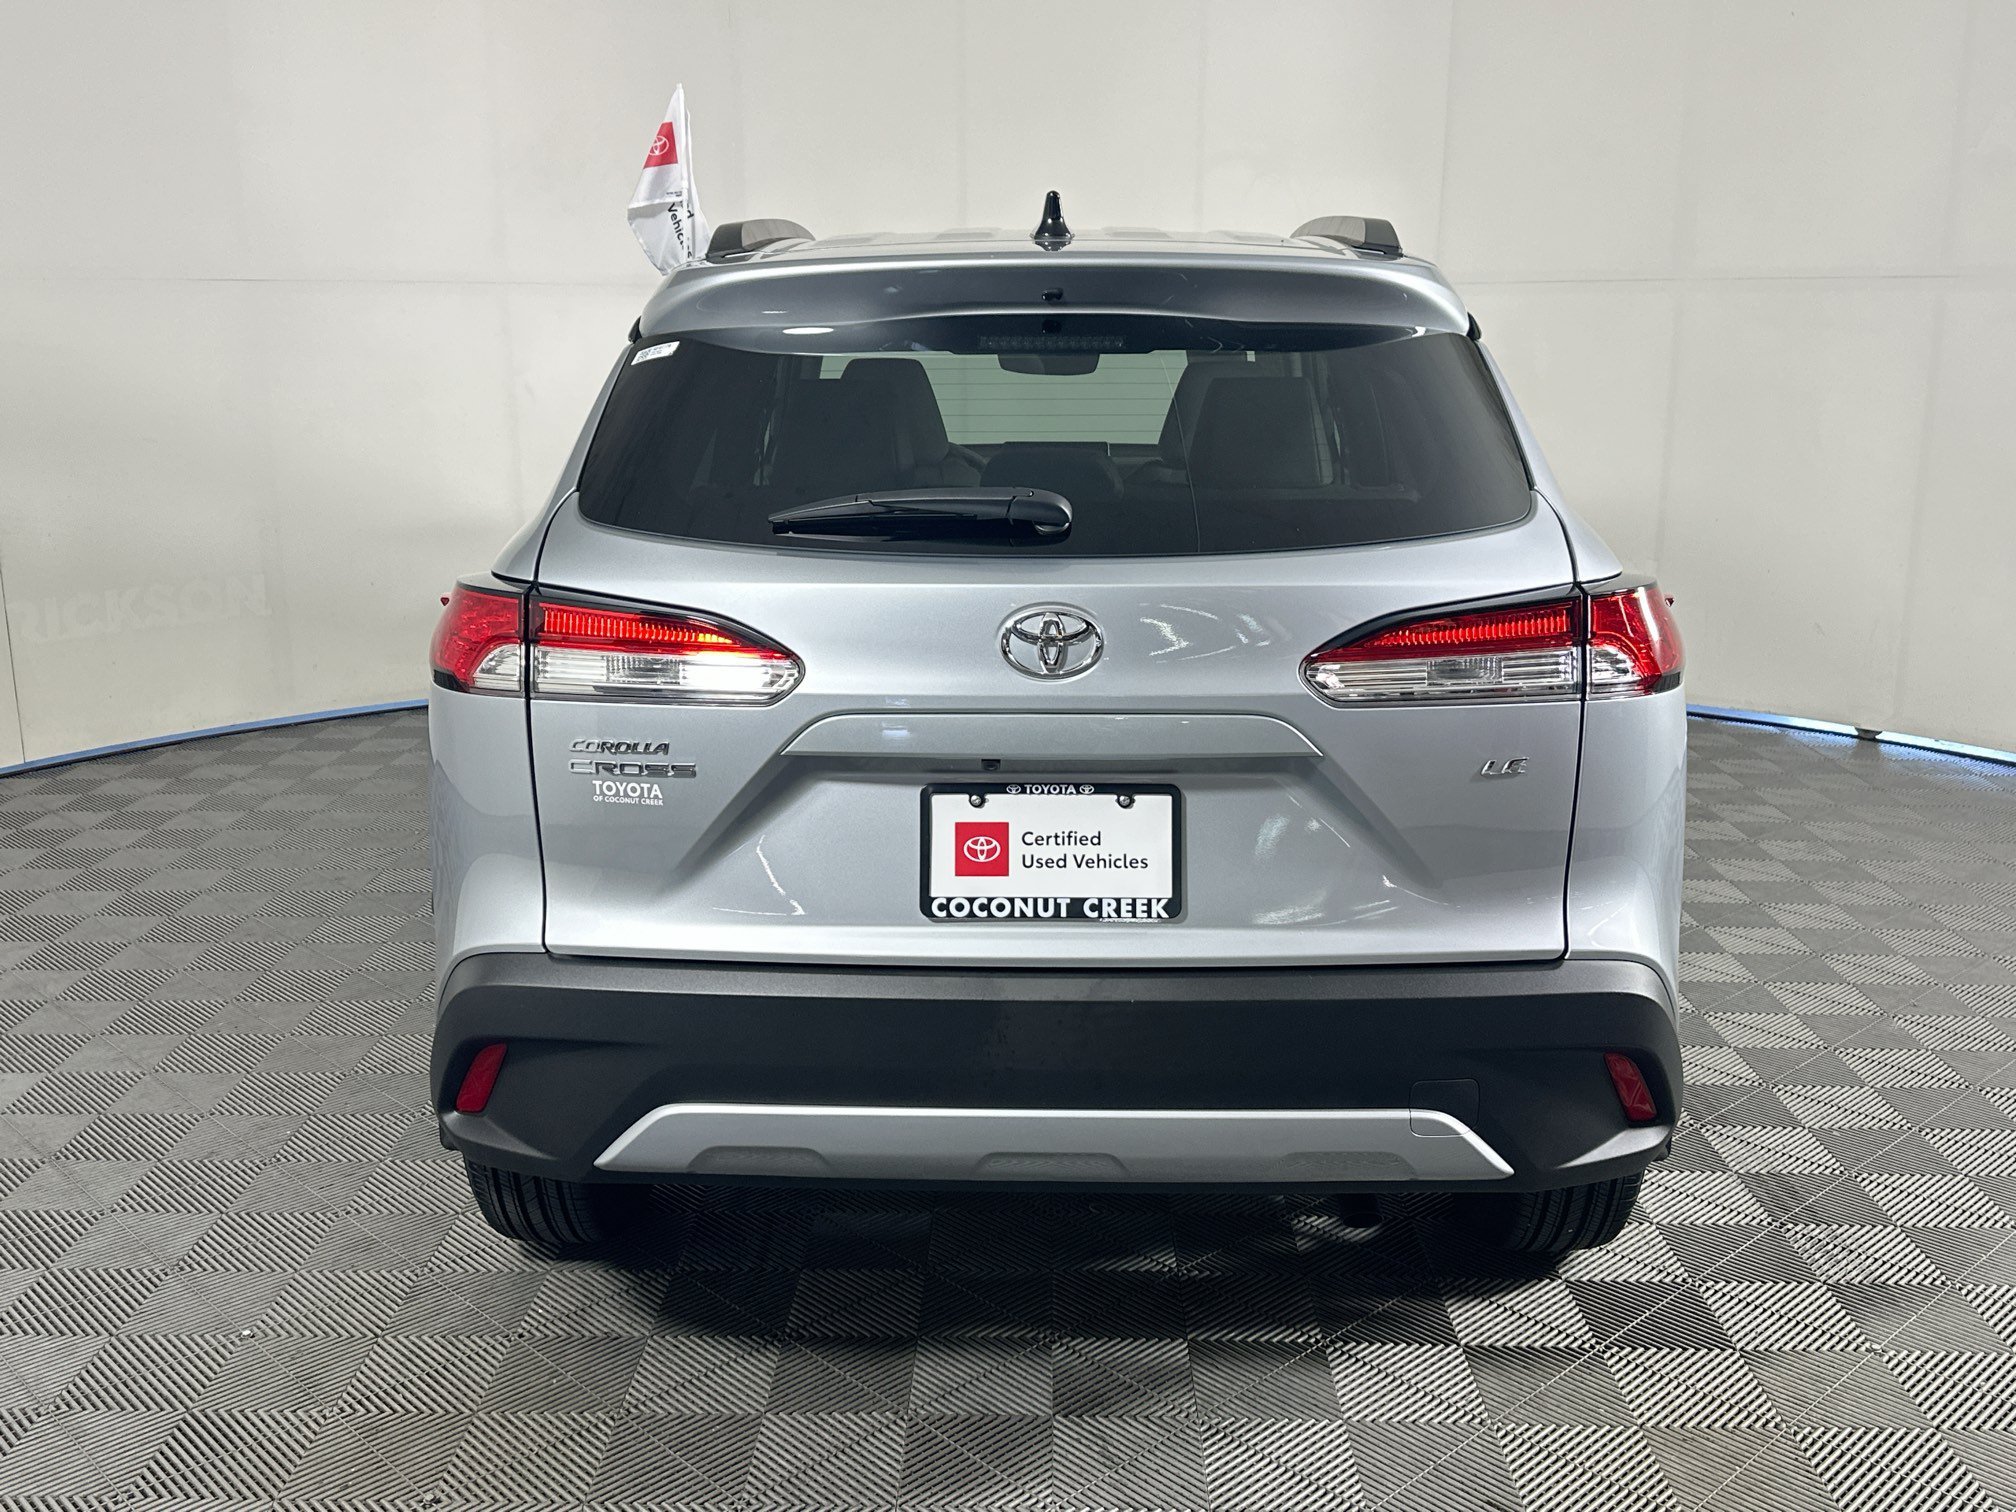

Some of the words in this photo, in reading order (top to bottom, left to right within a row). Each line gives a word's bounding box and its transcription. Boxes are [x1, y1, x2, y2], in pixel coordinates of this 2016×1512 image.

[568, 738, 670, 755] COROLLA
[568, 758, 697, 778] CROSS
[1481, 757, 1528, 775] LE
[592, 780, 663, 799] TOYOTA
[1024, 784, 1077, 795] TOYOTA
[604, 795, 640, 804] COCONUT
[1021, 831, 1102, 847] Certified
[1022, 853, 1068, 869] Used
[1073, 853, 1149, 869] Vehicles
[931, 897, 1071, 918] COCONUT
[1083, 898, 1169, 918] CREEK
